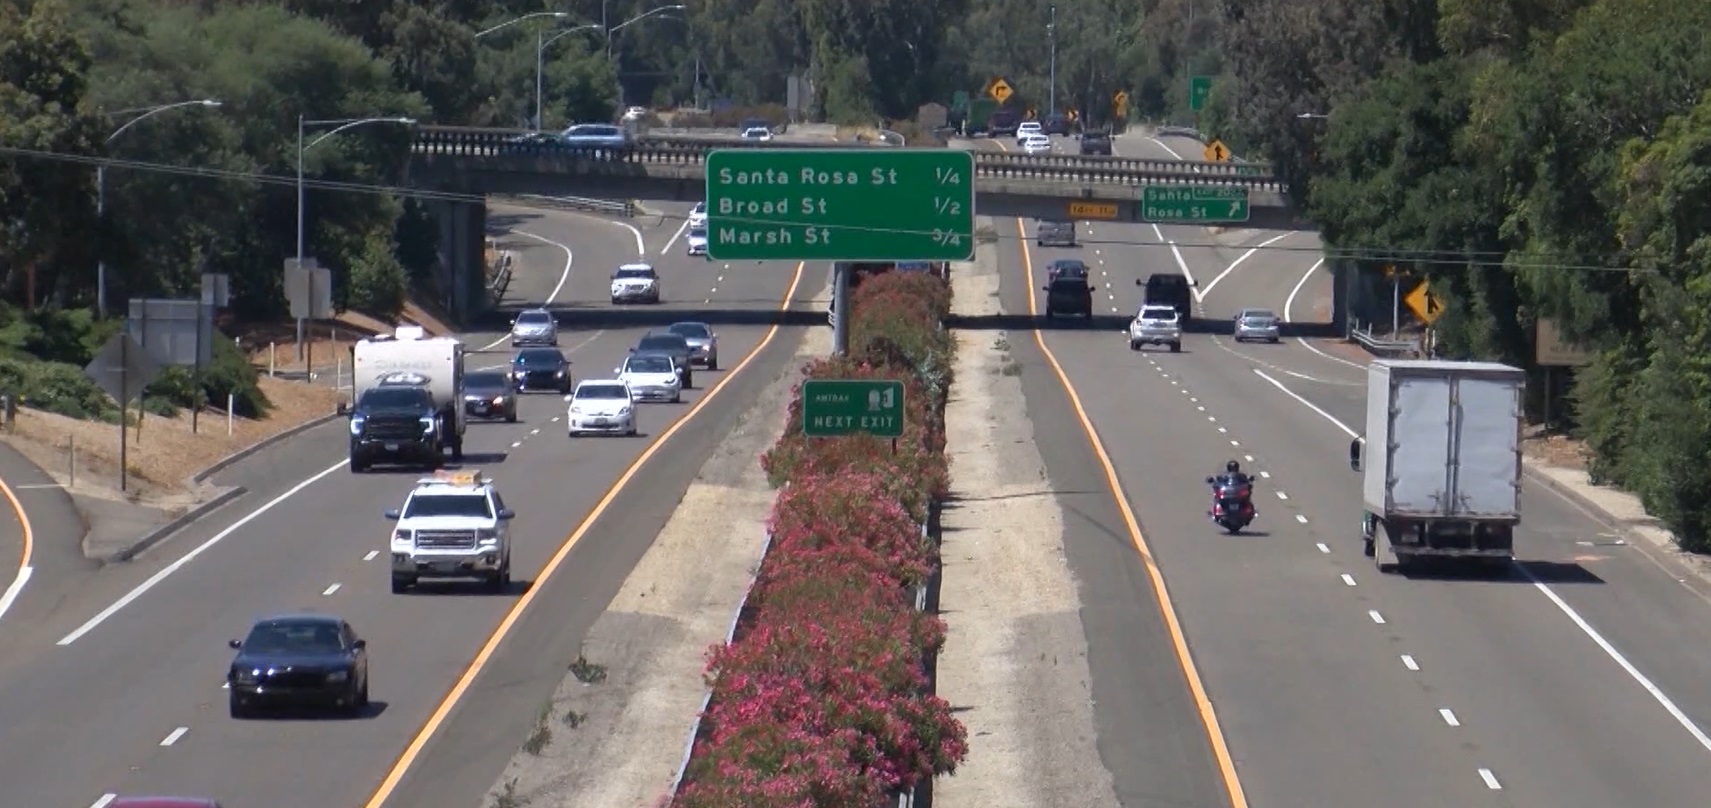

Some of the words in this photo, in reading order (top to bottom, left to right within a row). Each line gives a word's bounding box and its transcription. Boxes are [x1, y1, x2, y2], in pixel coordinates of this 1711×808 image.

[719, 167, 789, 185] Santa
[801, 167, 859, 185] Rosa
[871, 167, 898, 185] St
[935, 166, 961, 185] 1/4
[1148, 189, 1191, 201] Santa
[719, 197, 788, 214] Broad
[801, 197, 827, 215] St
[934, 196, 961, 215] 1/2
[1147, 206, 1183, 218] Rosa
[1191, 206, 1207, 218] St
[719, 227, 792, 244] Marsh
[804, 227, 831, 244] St
[931, 228, 961, 247] 3/4
[814, 415, 853, 428] NEXT
[861, 415, 894, 428] EXIT
